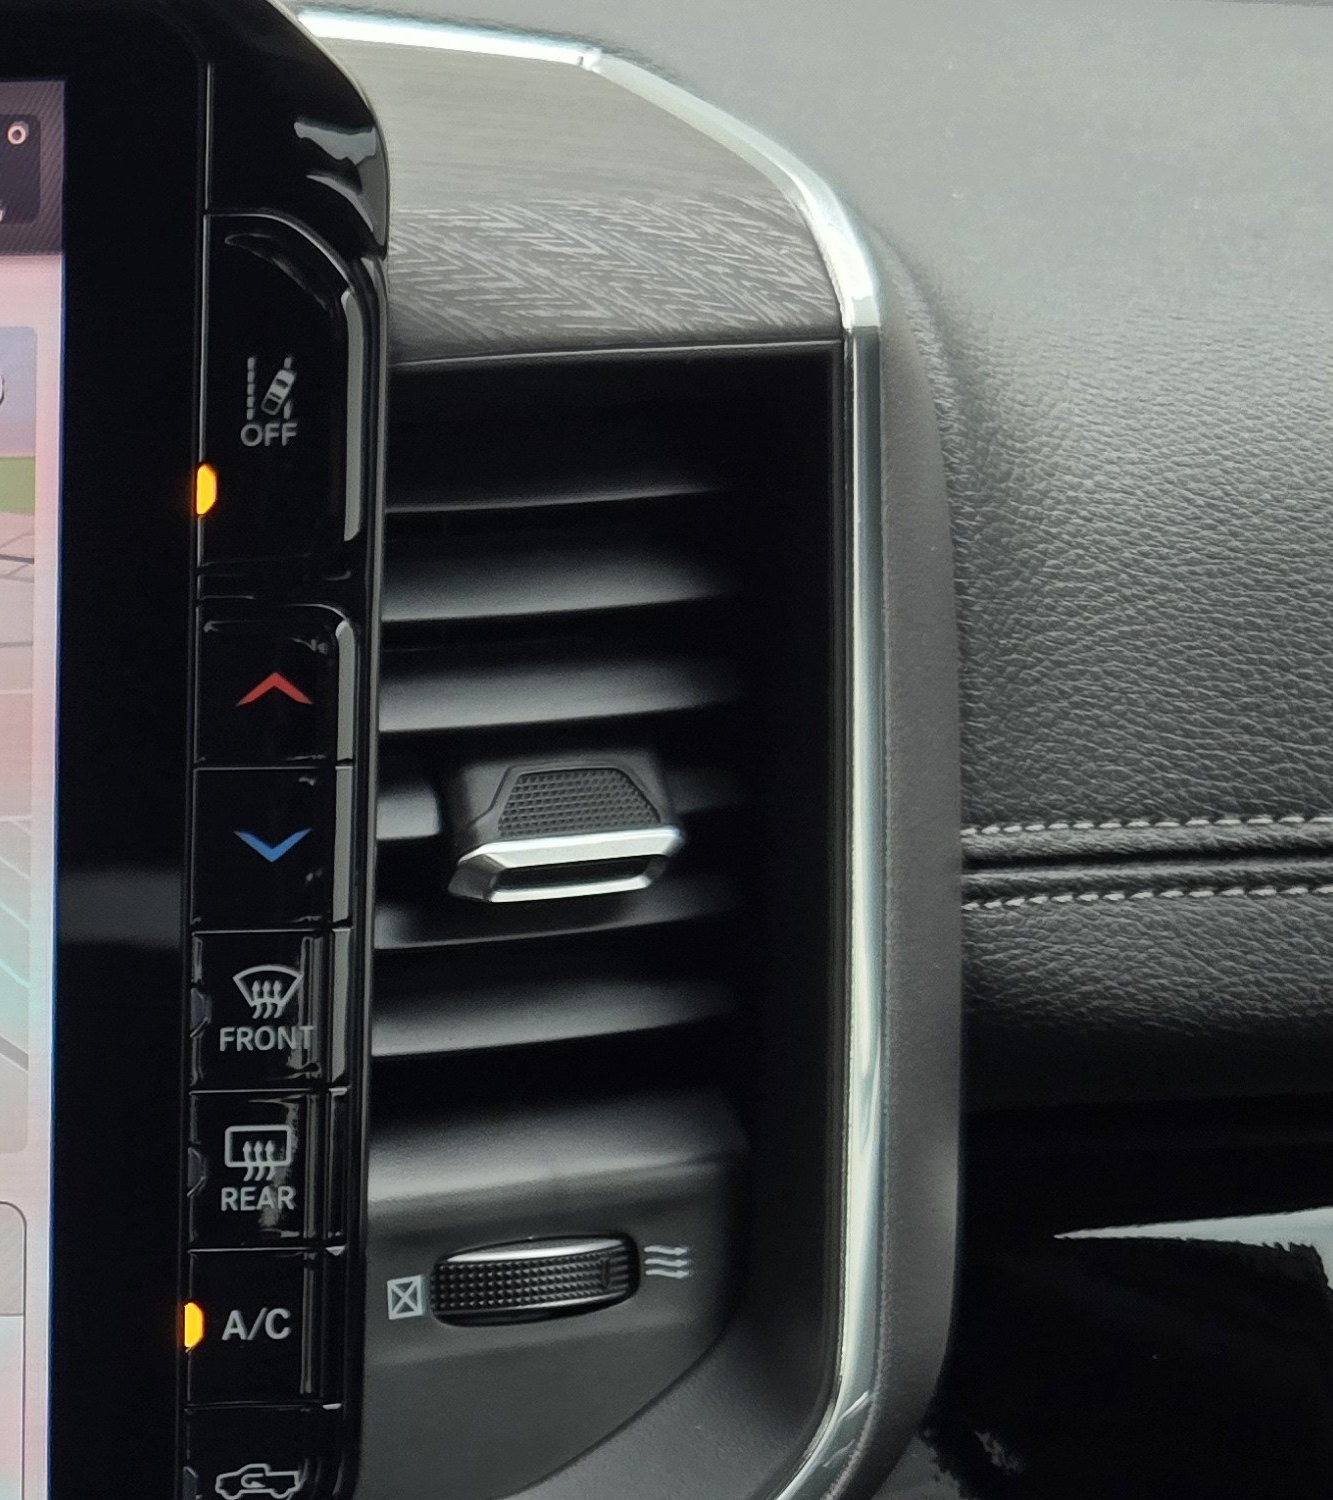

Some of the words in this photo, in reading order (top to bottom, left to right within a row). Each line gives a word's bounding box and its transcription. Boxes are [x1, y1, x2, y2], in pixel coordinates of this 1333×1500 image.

[240, 422, 298, 447] OFF
[219, 1025, 315, 1052] FRONT
[220, 1187, 296, 1212] REAR
[221, 1307, 292, 1341] A/C
